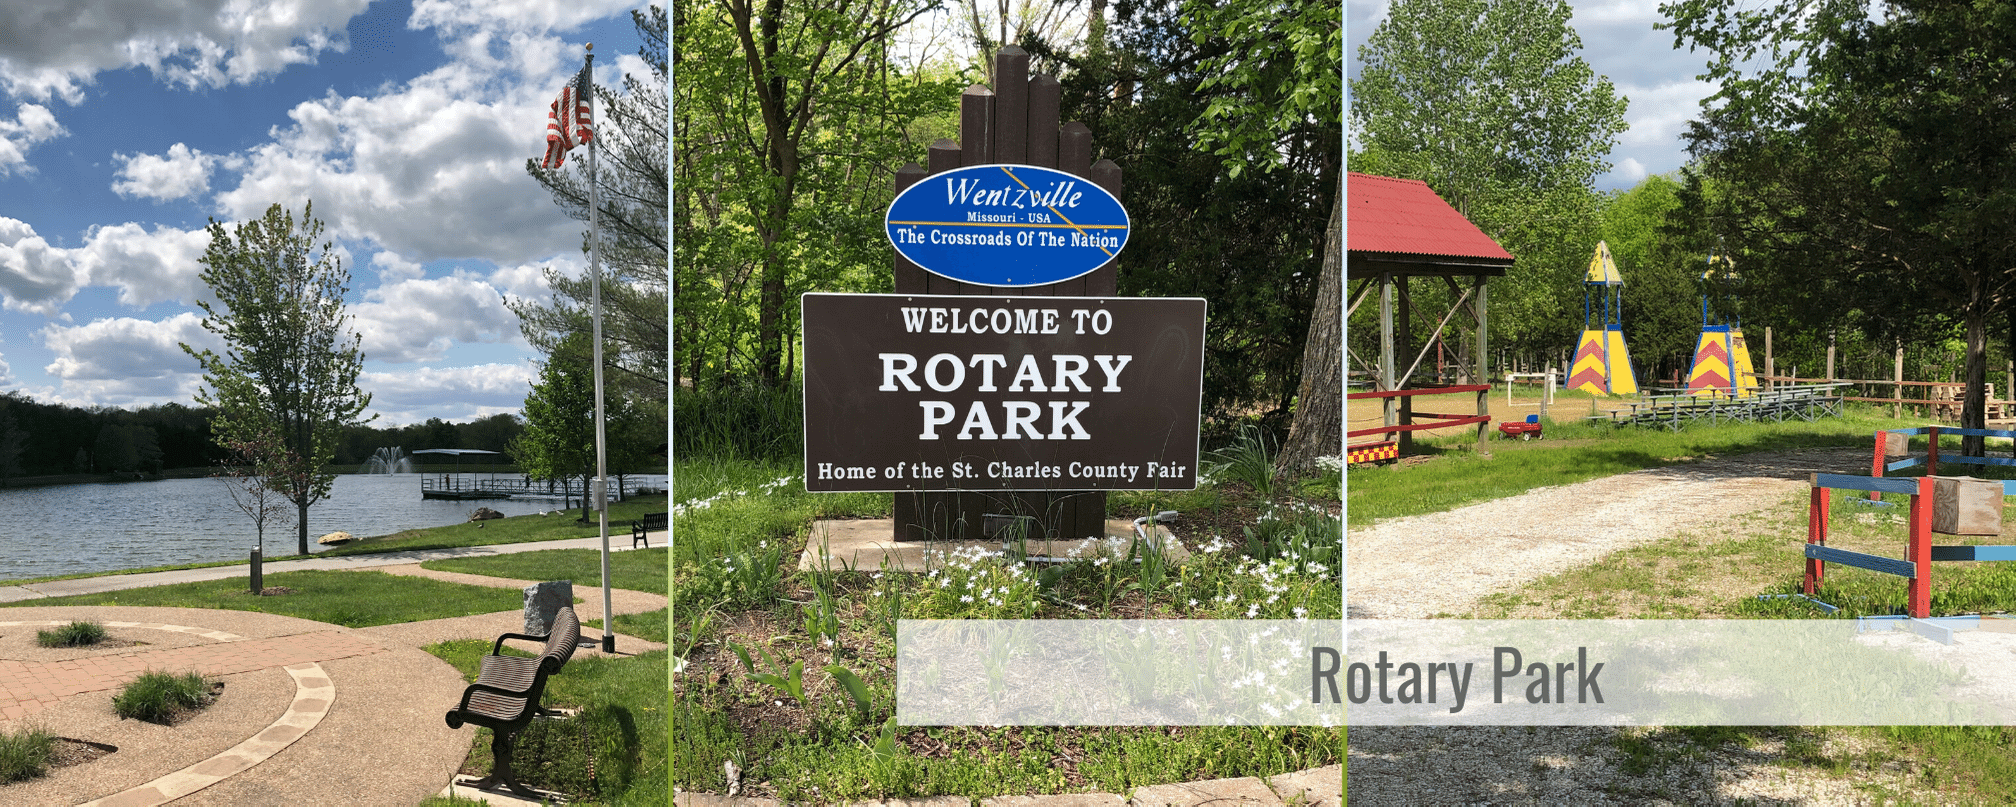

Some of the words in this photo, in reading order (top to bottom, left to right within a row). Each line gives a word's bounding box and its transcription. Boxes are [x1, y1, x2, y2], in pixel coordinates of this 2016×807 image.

[946, 177, 1083, 209] Wentzville
[967, 211, 1016, 223] Missouri
[1028, 213, 1051, 224] USA
[897, 228, 925, 244] The
[931, 229, 1012, 246] Crossroads
[1017, 230, 1035, 247] Of
[1039, 231, 1066, 247] The
[1071, 231, 1119, 249] Nation
[900, 306, 1060, 335] WELCOME
[1071, 308, 1113, 336] TO
[878, 352, 1133, 393] ROTARY
[918, 400, 1092, 441] PARK
[817, 462, 877, 480] Home
[885, 461, 906, 480] of
[911, 461, 944, 480] the
[951, 461, 979, 479] St.
[987, 460, 1062, 480] Charles
[1068, 461, 1140, 484] County
[1146, 460, 1187, 479] Fair
